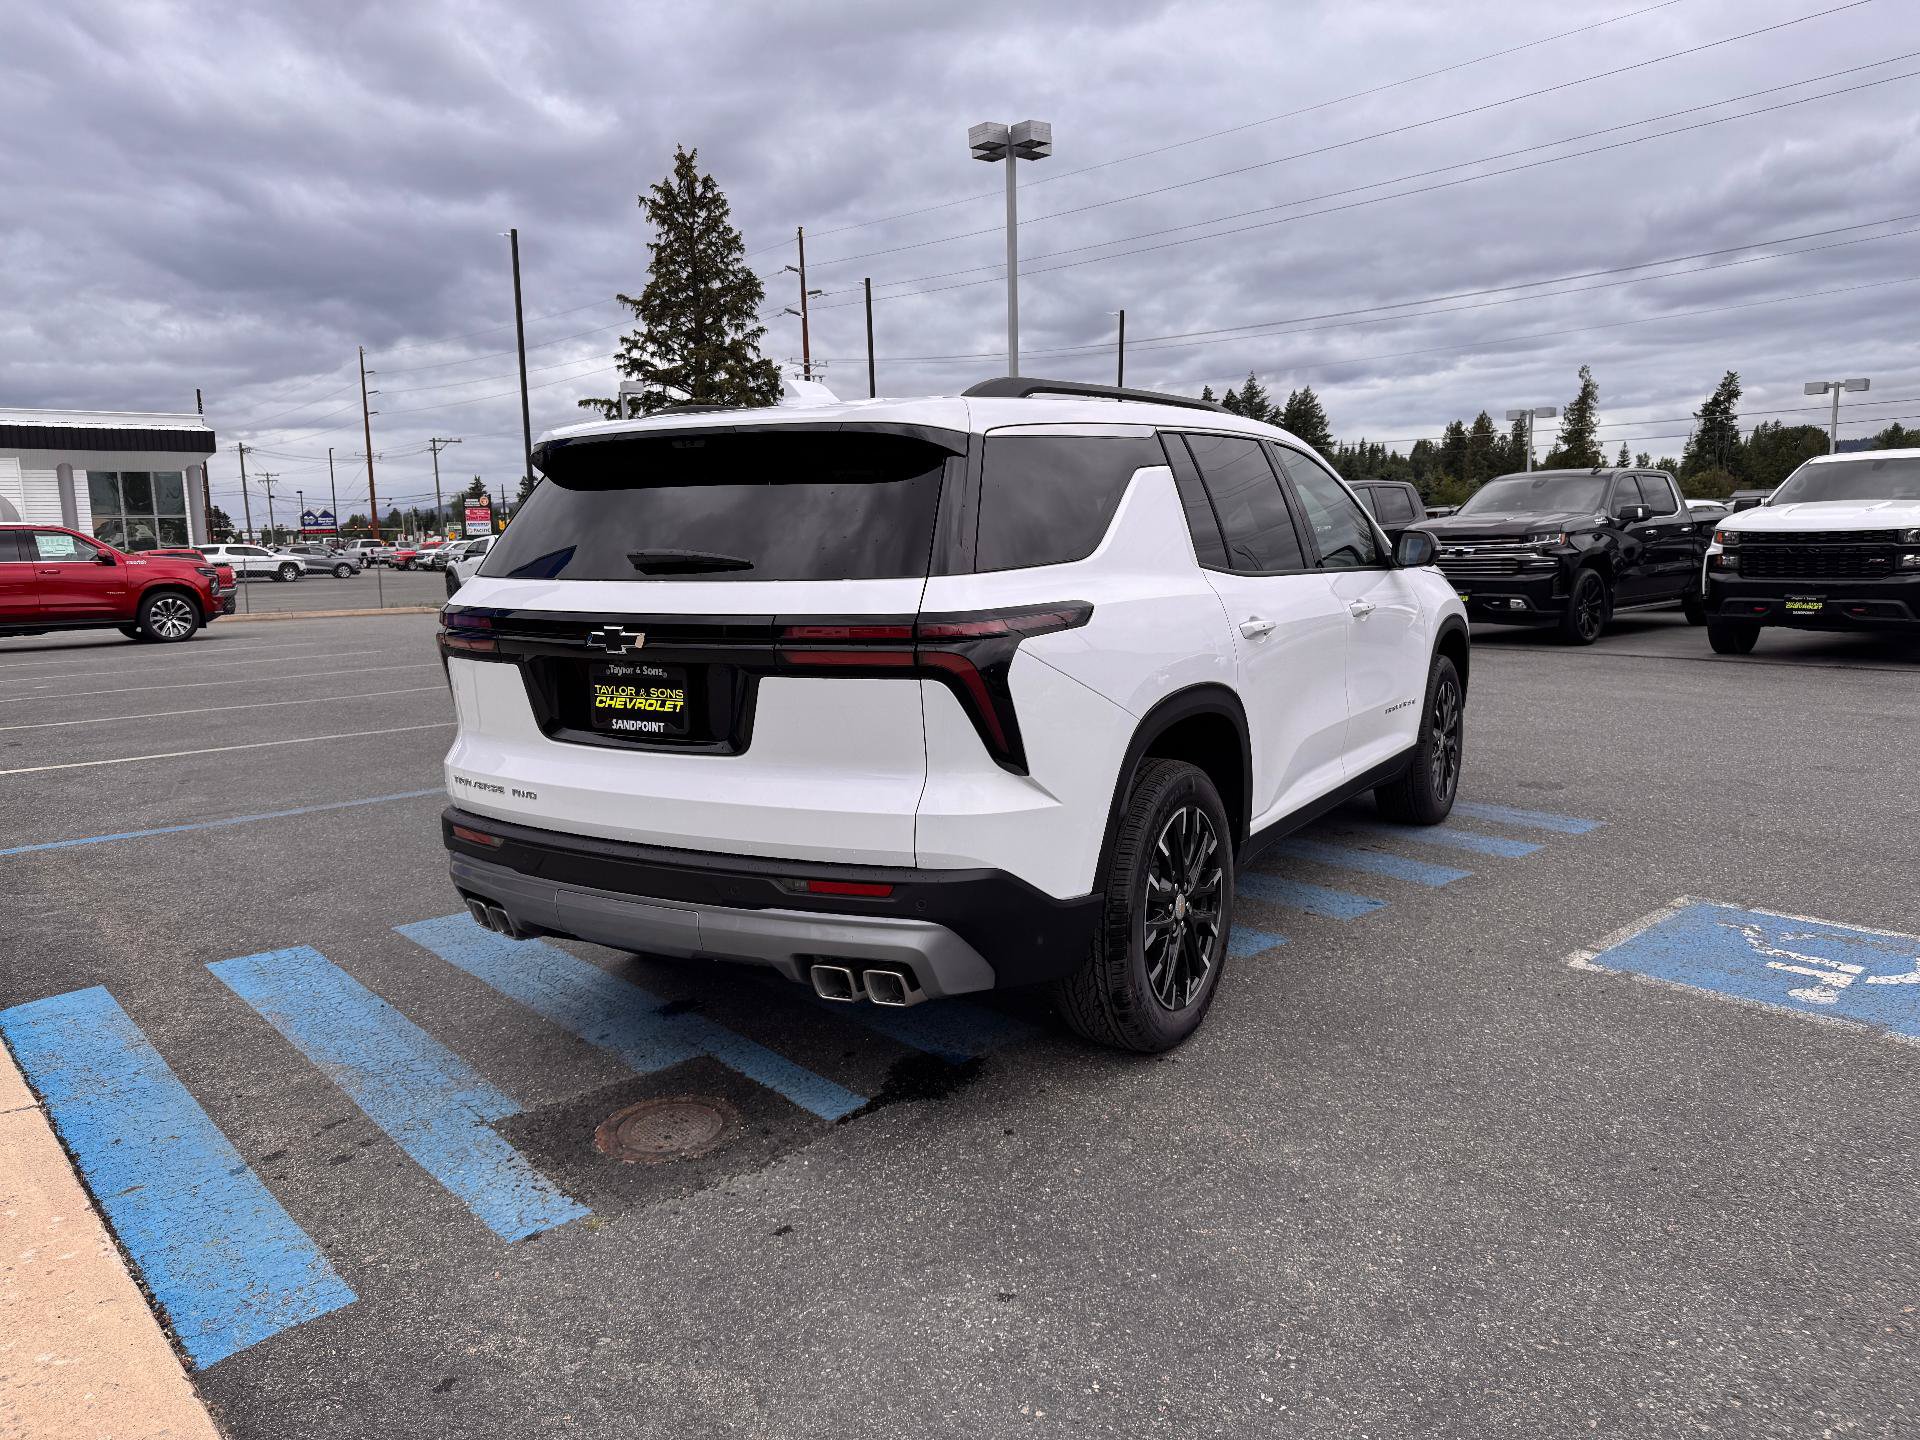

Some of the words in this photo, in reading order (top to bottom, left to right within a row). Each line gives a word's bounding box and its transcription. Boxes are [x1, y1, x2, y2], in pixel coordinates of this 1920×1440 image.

[608, 664, 634, 677] Taylor
[636, 666, 641, 674] &
[642, 665, 664, 677] Sons
[594, 685, 636, 696] TAYLOR
[639, 688, 647, 698] &
[650, 688, 684, 699] SONS
[595, 697, 684, 712] CHEVROLET
[611, 719, 665, 733] SANDPOINT
